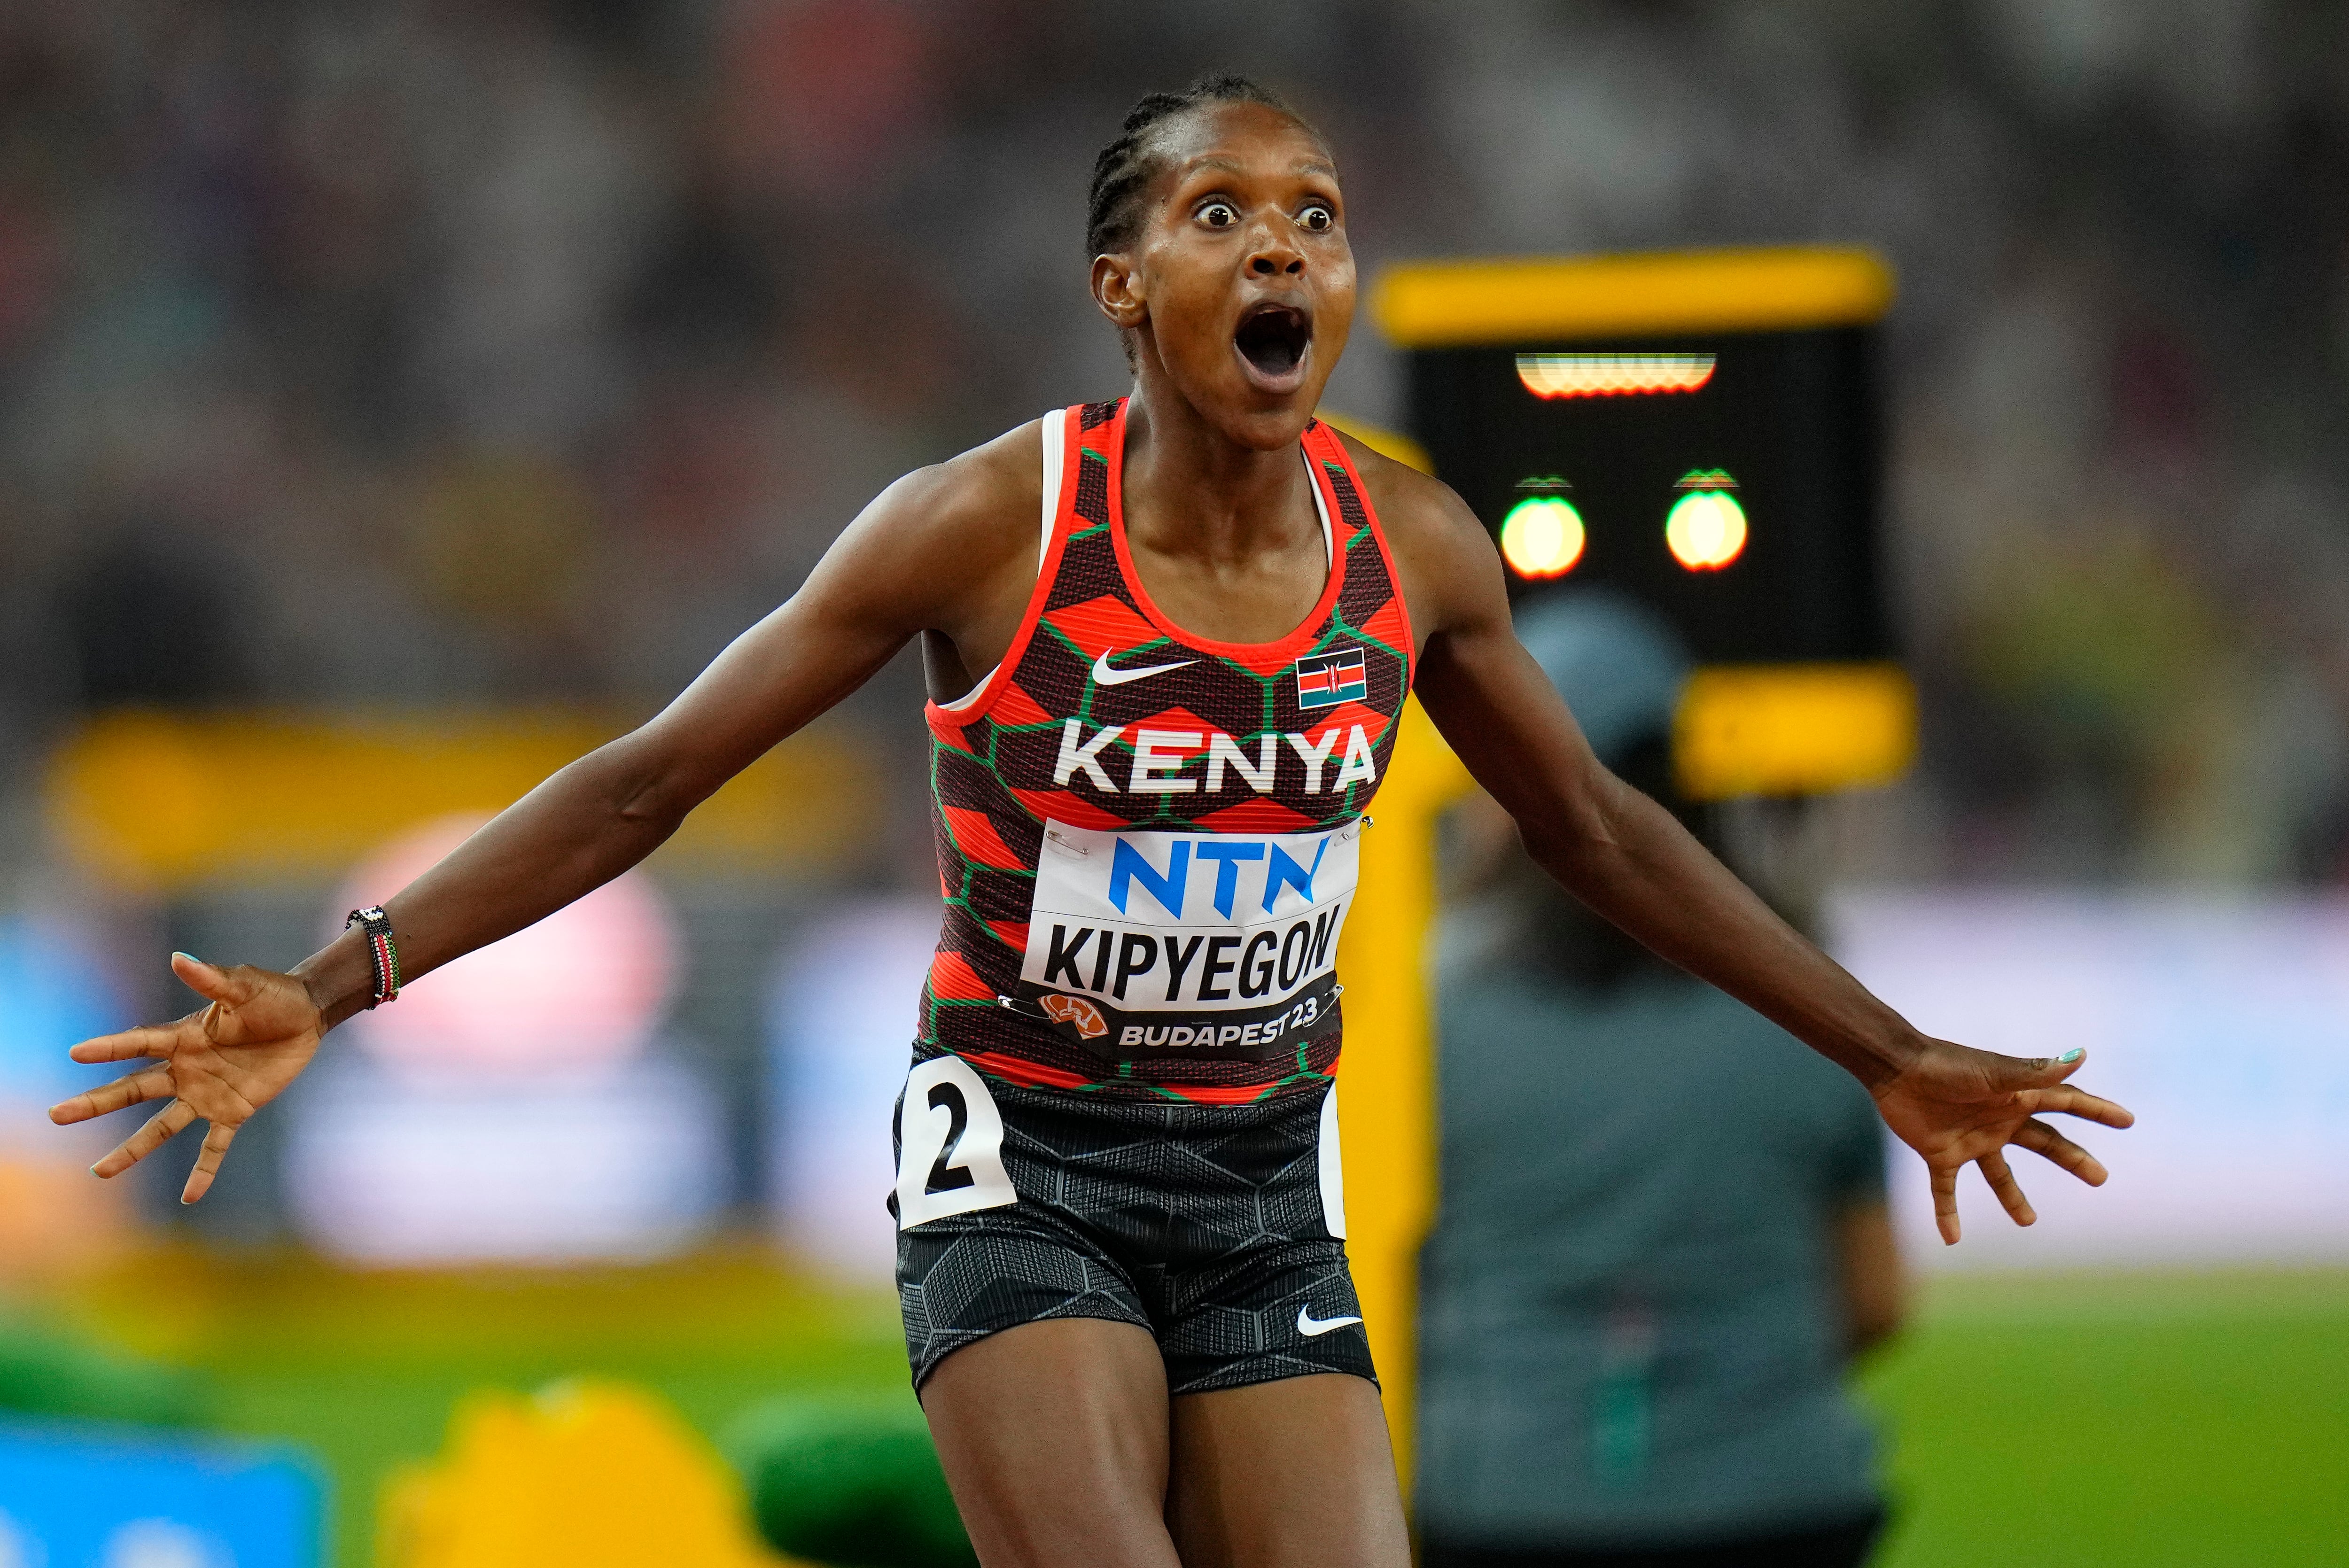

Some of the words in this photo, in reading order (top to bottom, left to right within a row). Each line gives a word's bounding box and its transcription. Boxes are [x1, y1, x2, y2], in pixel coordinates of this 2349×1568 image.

[1053, 719, 1377, 795] KENYA
[1108, 836, 1331, 921] NTN
[1043, 903, 1341, 1001] KIPYEGON
[1119, 1011, 1291, 1047] BUDAPEST
[1291, 997, 1317, 1029] 23
[925, 1082, 975, 1195] 2
